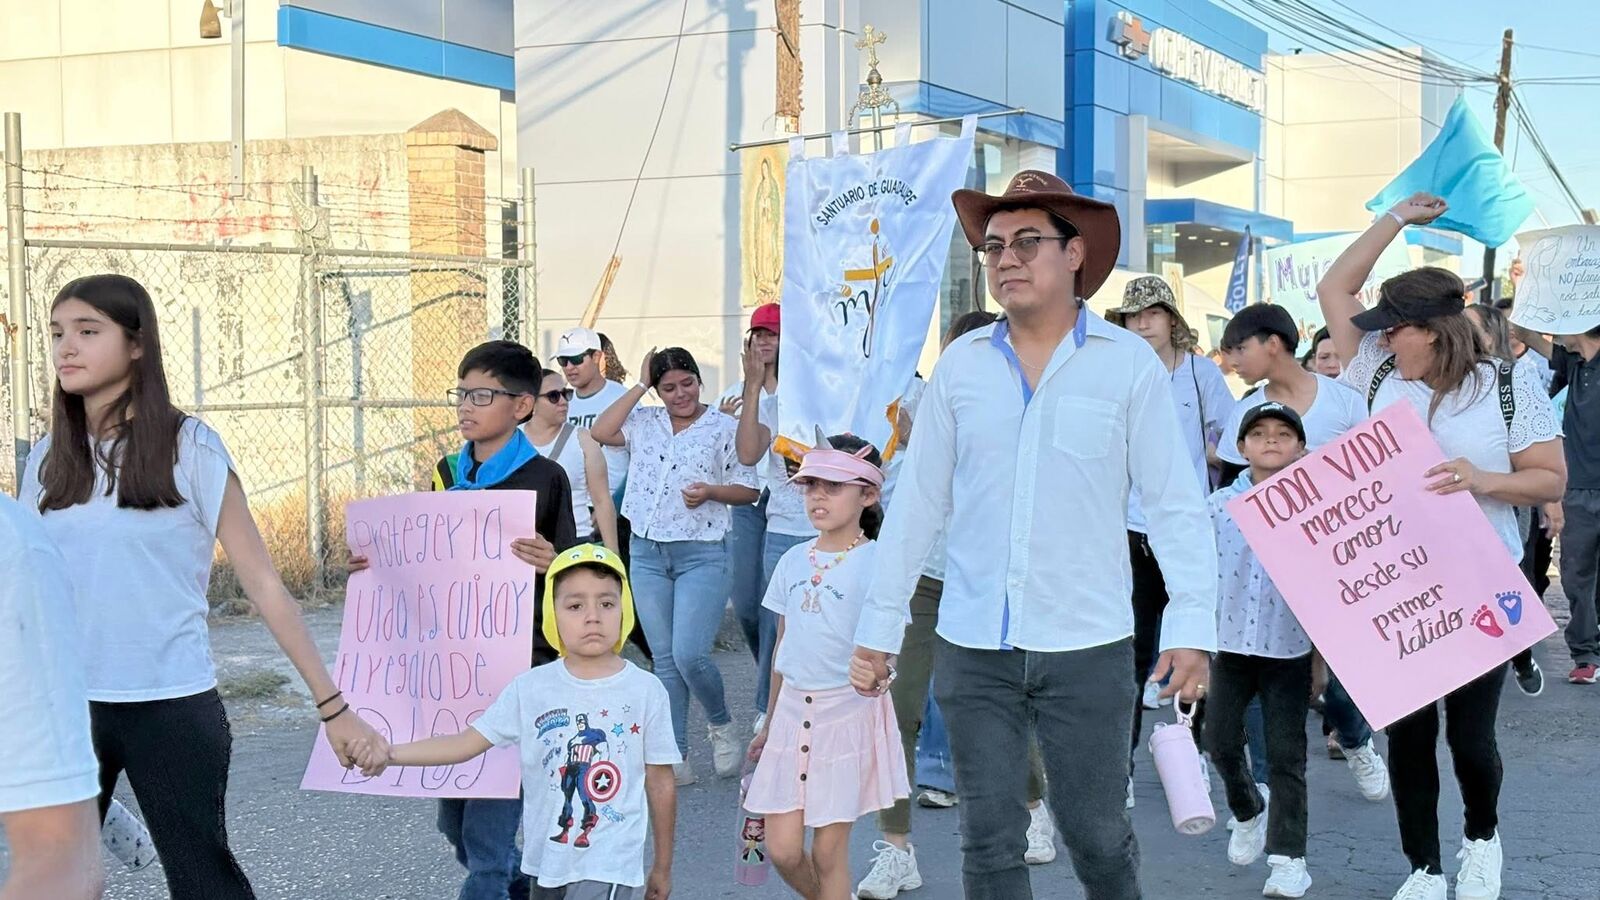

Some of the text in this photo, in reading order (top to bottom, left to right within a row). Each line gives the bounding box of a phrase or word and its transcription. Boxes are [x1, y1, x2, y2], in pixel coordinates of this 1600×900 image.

[816, 186, 865, 226] SANTUARIO
[868, 181, 878, 198] DE
[1558, 271, 1574, 286] NO
[1244, 419, 1403, 530] TODA VIDA
[473, 505, 502, 561] la
[1300, 479, 1393, 546] merece
[1332, 514, 1403, 567] amor
[1337, 545, 1429, 606] desde su
[418, 584, 438, 643] es
[1371, 583, 1444, 642] primer
[1396, 607, 1464, 660] latido
